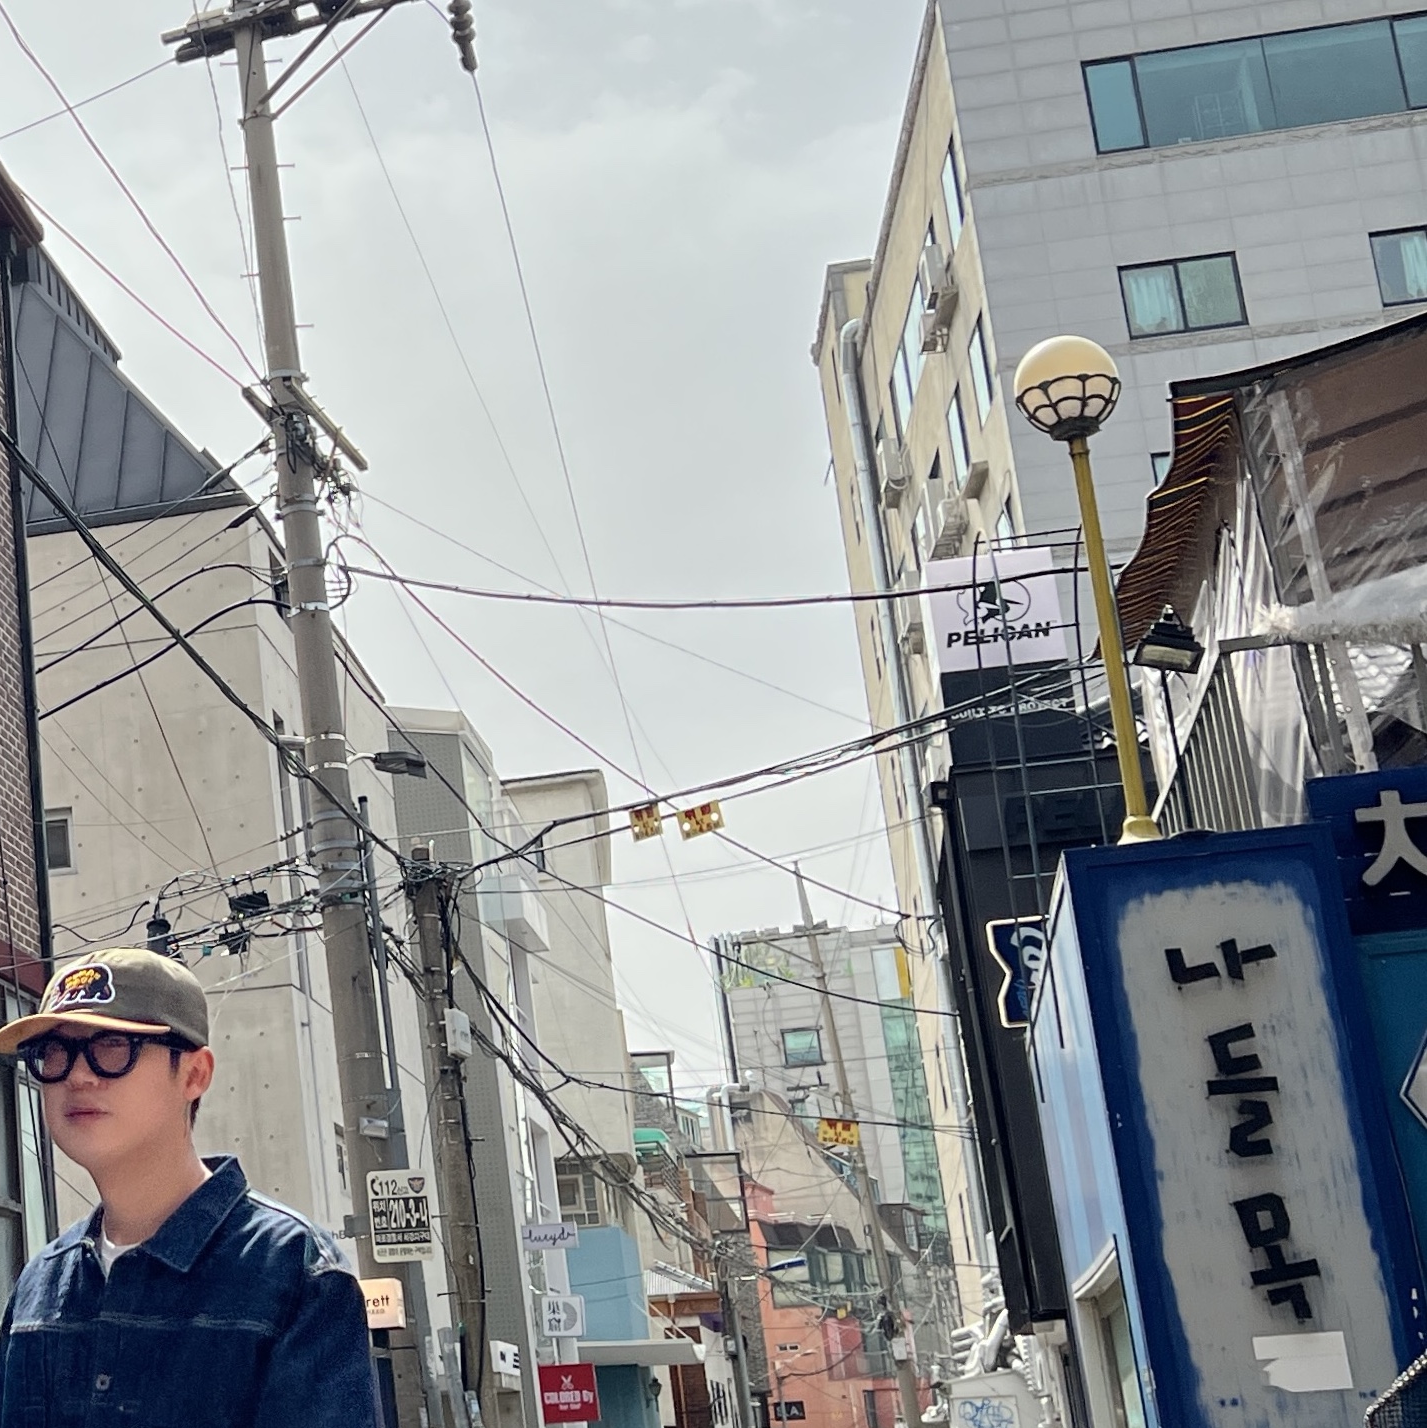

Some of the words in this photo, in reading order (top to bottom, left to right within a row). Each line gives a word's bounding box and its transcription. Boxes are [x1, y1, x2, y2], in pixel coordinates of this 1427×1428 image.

[947, 622, 1051, 648] PELICAN
[1165, 938, 1320, 1321] 나들목
[378, 1179, 397, 1196] 112
[389, 1198, 429, 1229] 210-3-4
